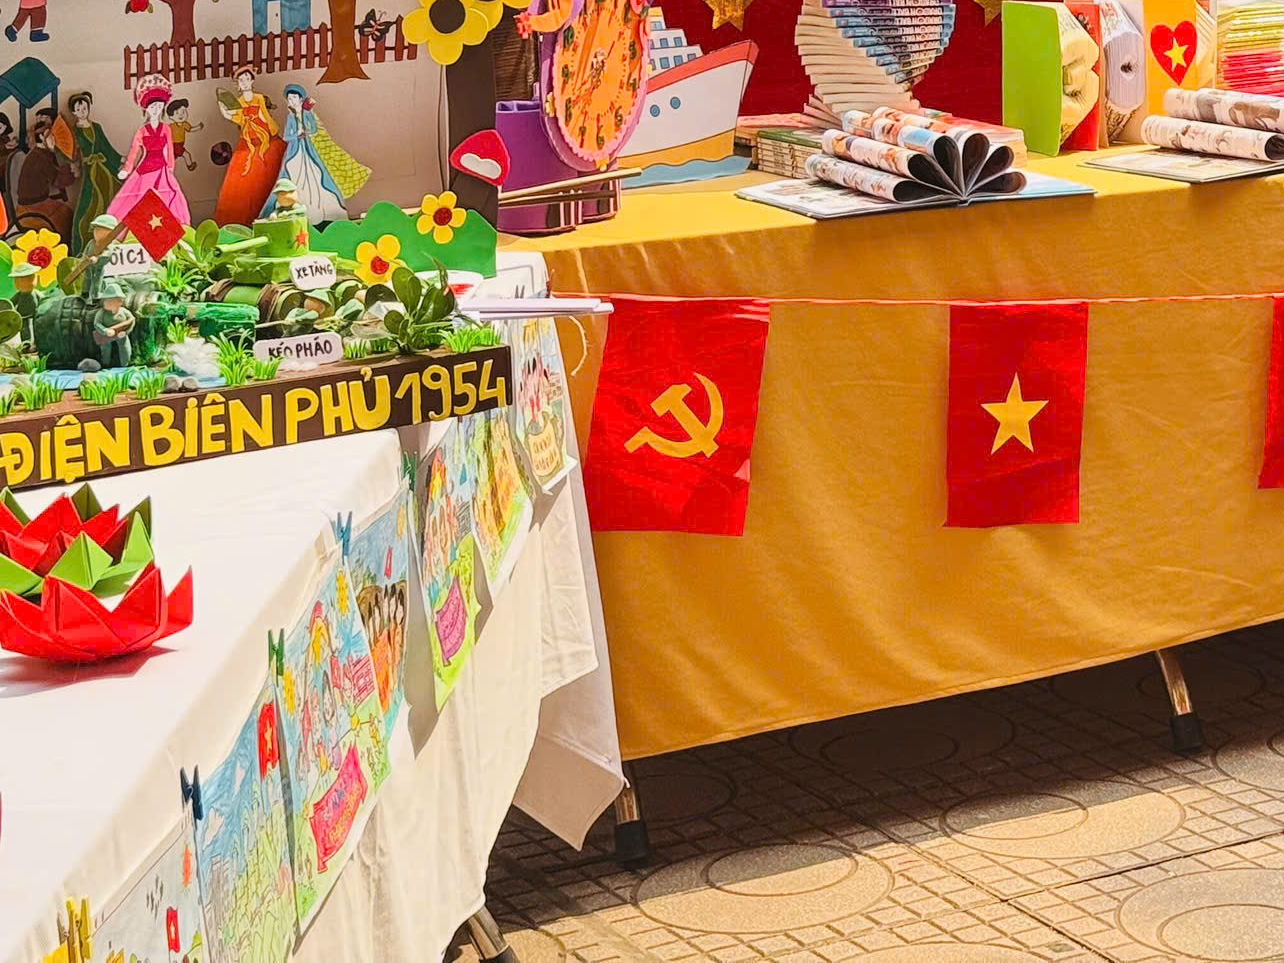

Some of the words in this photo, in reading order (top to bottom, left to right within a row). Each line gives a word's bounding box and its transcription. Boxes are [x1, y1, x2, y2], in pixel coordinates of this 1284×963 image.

[126, 248, 147, 264] C1
[295, 266, 308, 279] XE
[308, 260, 333, 278] TĂNG
[295, 335, 333, 358] PHÁO
[0, 414, 131, 486] ĐIỆN
[285, 366, 391, 445] PHỦ
[394, 358, 506, 425] 1954
